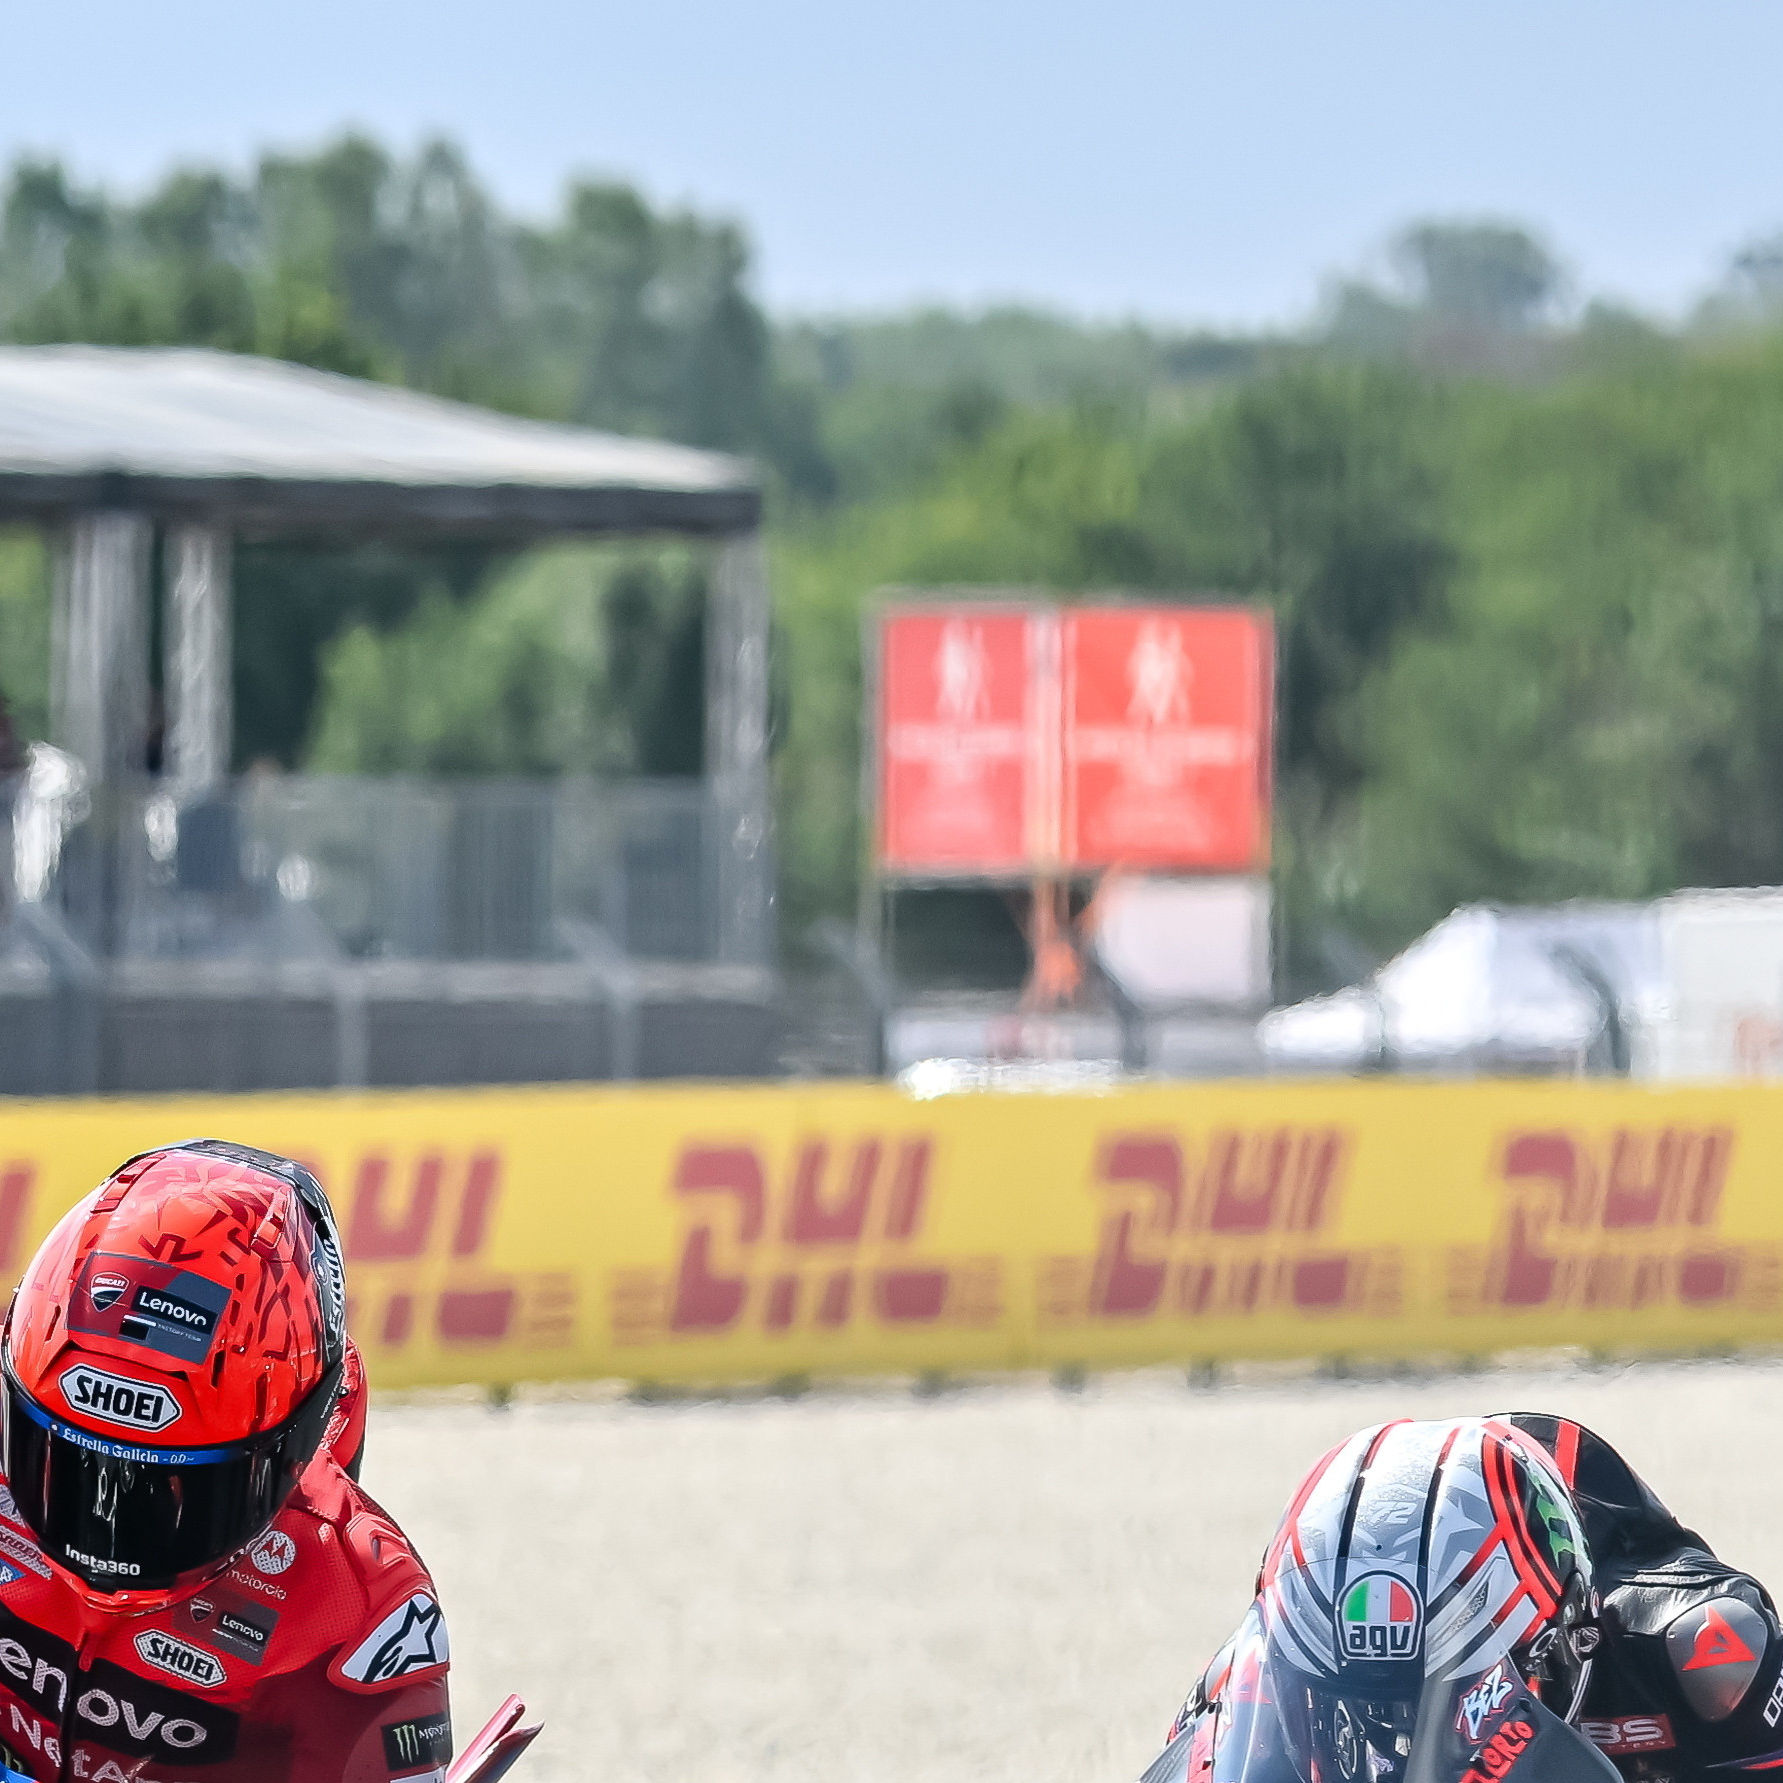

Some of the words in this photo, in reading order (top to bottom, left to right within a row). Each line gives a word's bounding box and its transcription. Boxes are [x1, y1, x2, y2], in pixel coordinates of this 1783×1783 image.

[667, 1128, 952, 1337] DHL
[1091, 1127, 1359, 1320] DHL
[1475, 1128, 1759, 1312] DHL
[139, 1291, 207, 1326] Lenovo
[74, 1374, 164, 1423] SHOEI
[62, 1428, 110, 1456] Estrella
[112, 1444, 159, 1464] Galicia
[65, 1543, 141, 1577] Insta360
[222, 1614, 264, 1641] Lenovo
[1349, 1624, 1411, 1658] agv
[147, 1636, 215, 1682] SHOEI
[1580, 1718, 1663, 1745] BS
